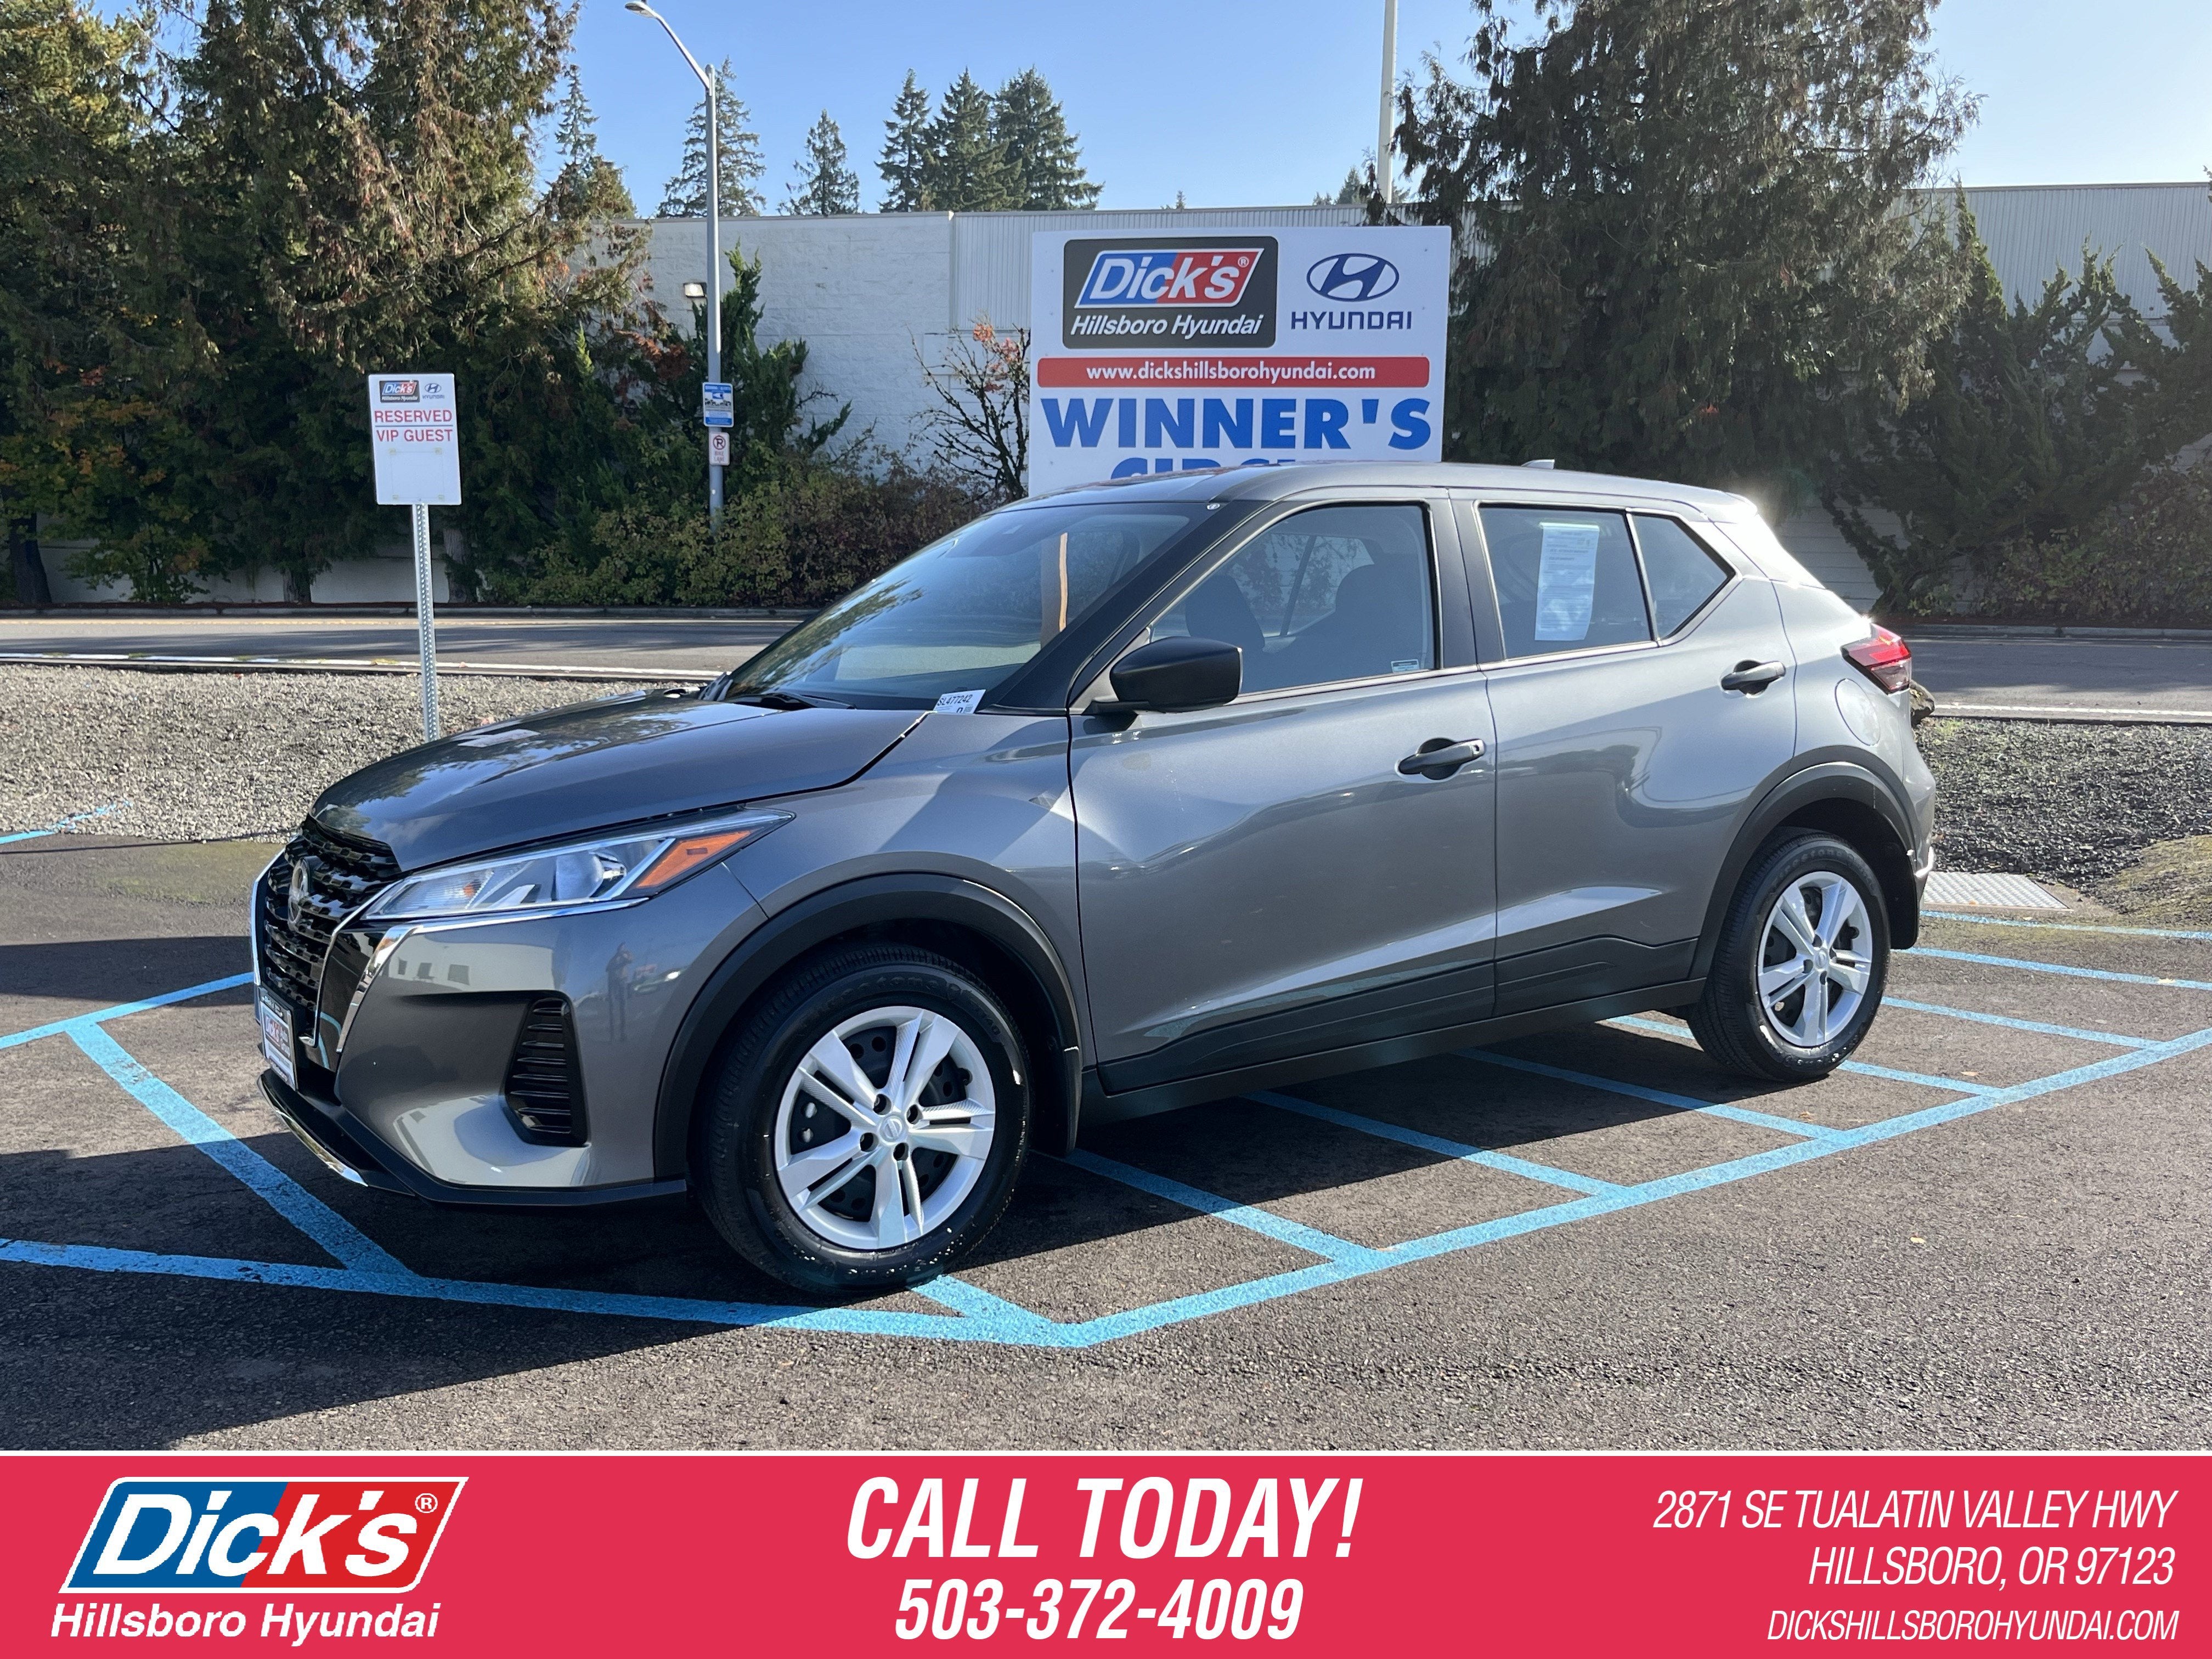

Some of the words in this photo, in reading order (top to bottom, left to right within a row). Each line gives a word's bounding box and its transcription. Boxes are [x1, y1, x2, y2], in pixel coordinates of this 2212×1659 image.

[1070, 315, 1168, 335] Hillsboro
[1171, 314, 1264, 340] Hyundai
[1291, 311, 1412, 330] HYUNDAI
[1086, 360, 1376, 384] www.dickshillsborohyundai.com
[374, 410, 453, 423] RESERVED
[1041, 398, 1432, 450] WINNER'S
[376, 430, 399, 442] VIP
[404, 429, 453, 442] GUEST
